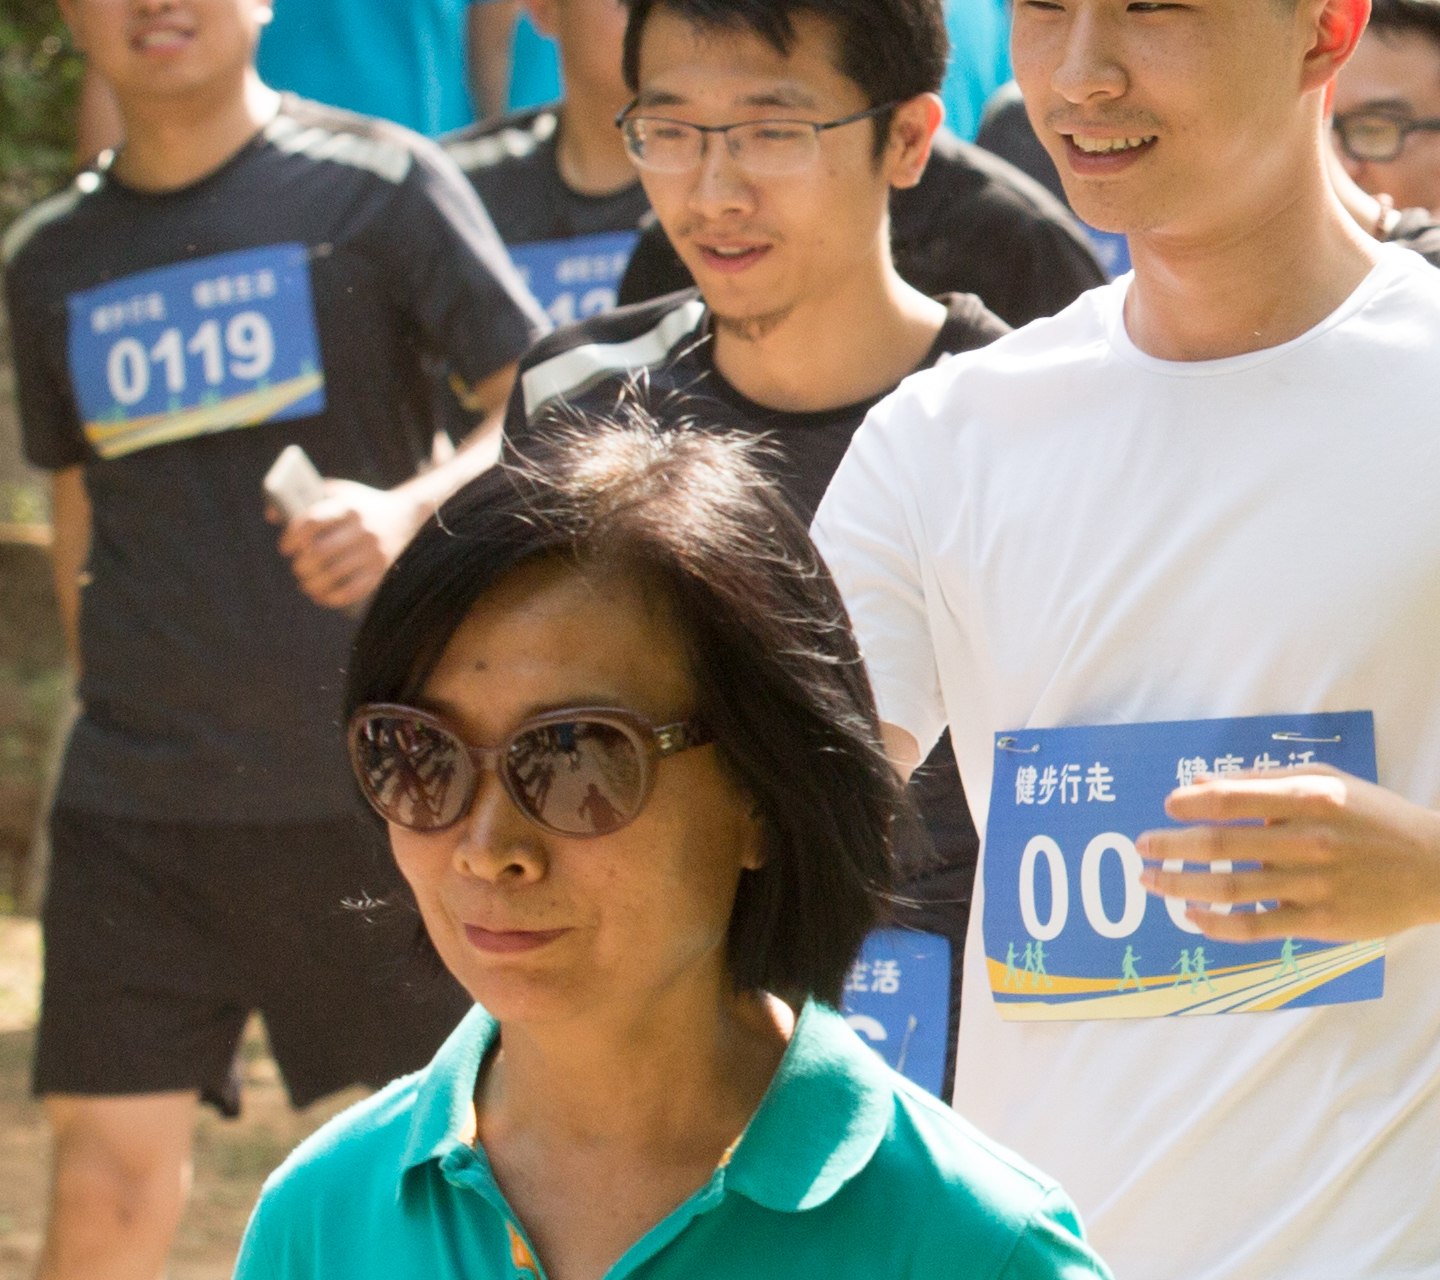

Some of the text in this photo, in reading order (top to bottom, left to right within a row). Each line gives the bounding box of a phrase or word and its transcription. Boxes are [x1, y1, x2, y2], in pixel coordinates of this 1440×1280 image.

[107, 310, 275, 406] 0119
[1015, 761, 1117, 805] 健步行走
[1018, 831, 1267, 942] 00
[842, 959, 902, 995] 生活
